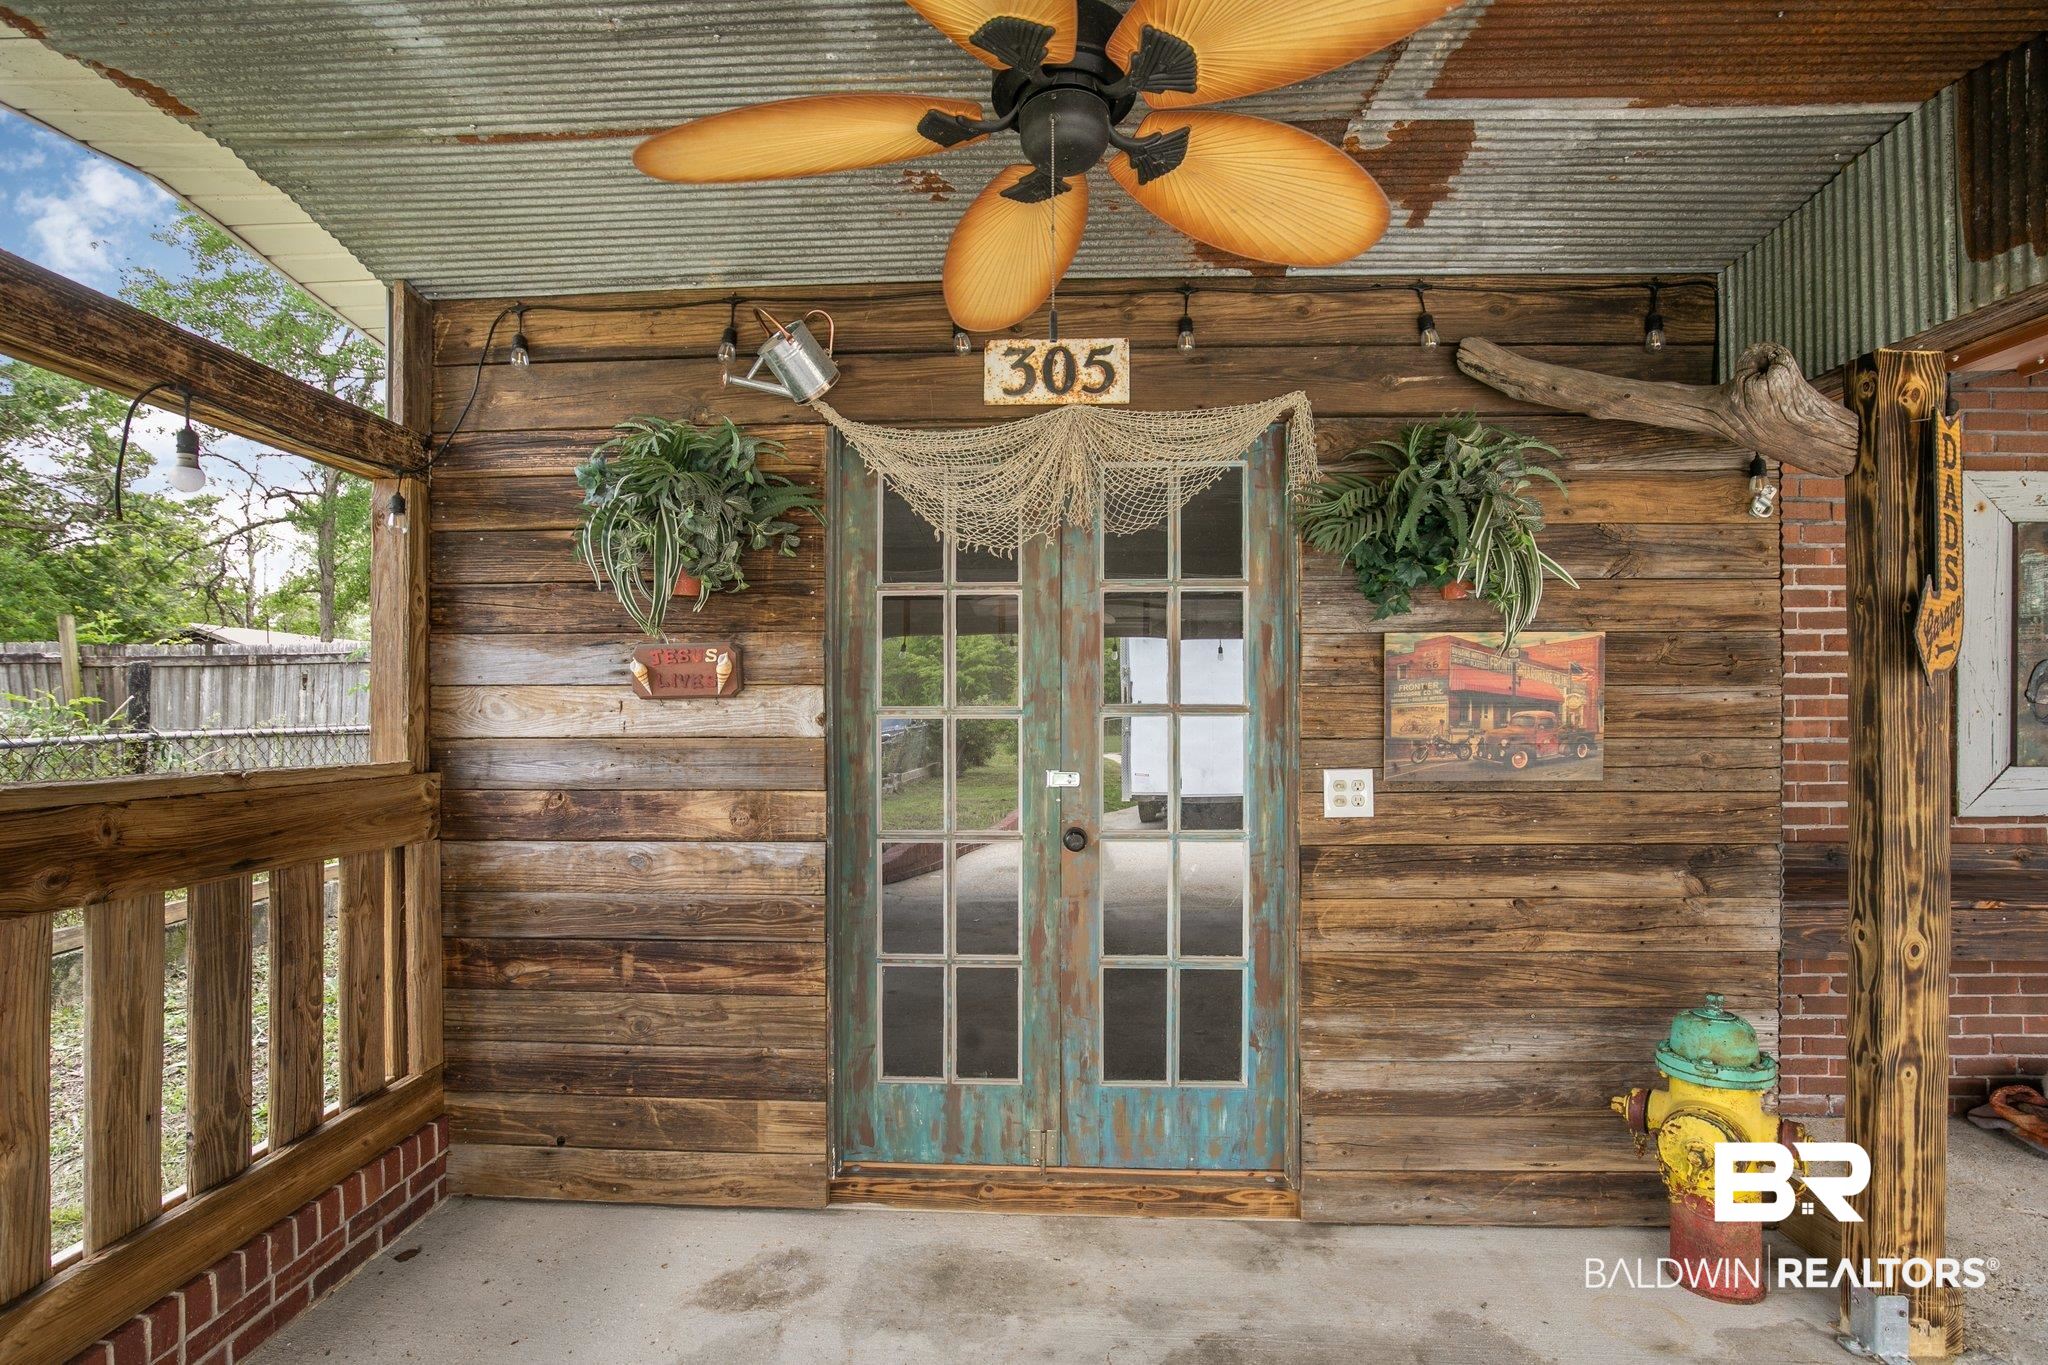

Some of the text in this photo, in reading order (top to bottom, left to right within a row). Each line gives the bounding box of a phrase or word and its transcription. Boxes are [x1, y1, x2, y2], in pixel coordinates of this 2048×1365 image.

[1002, 345, 1116, 396] 305
[649, 648, 718, 667] JESUS
[1425, 660, 1439, 669] 66
[657, 673, 718, 690] LIVES
